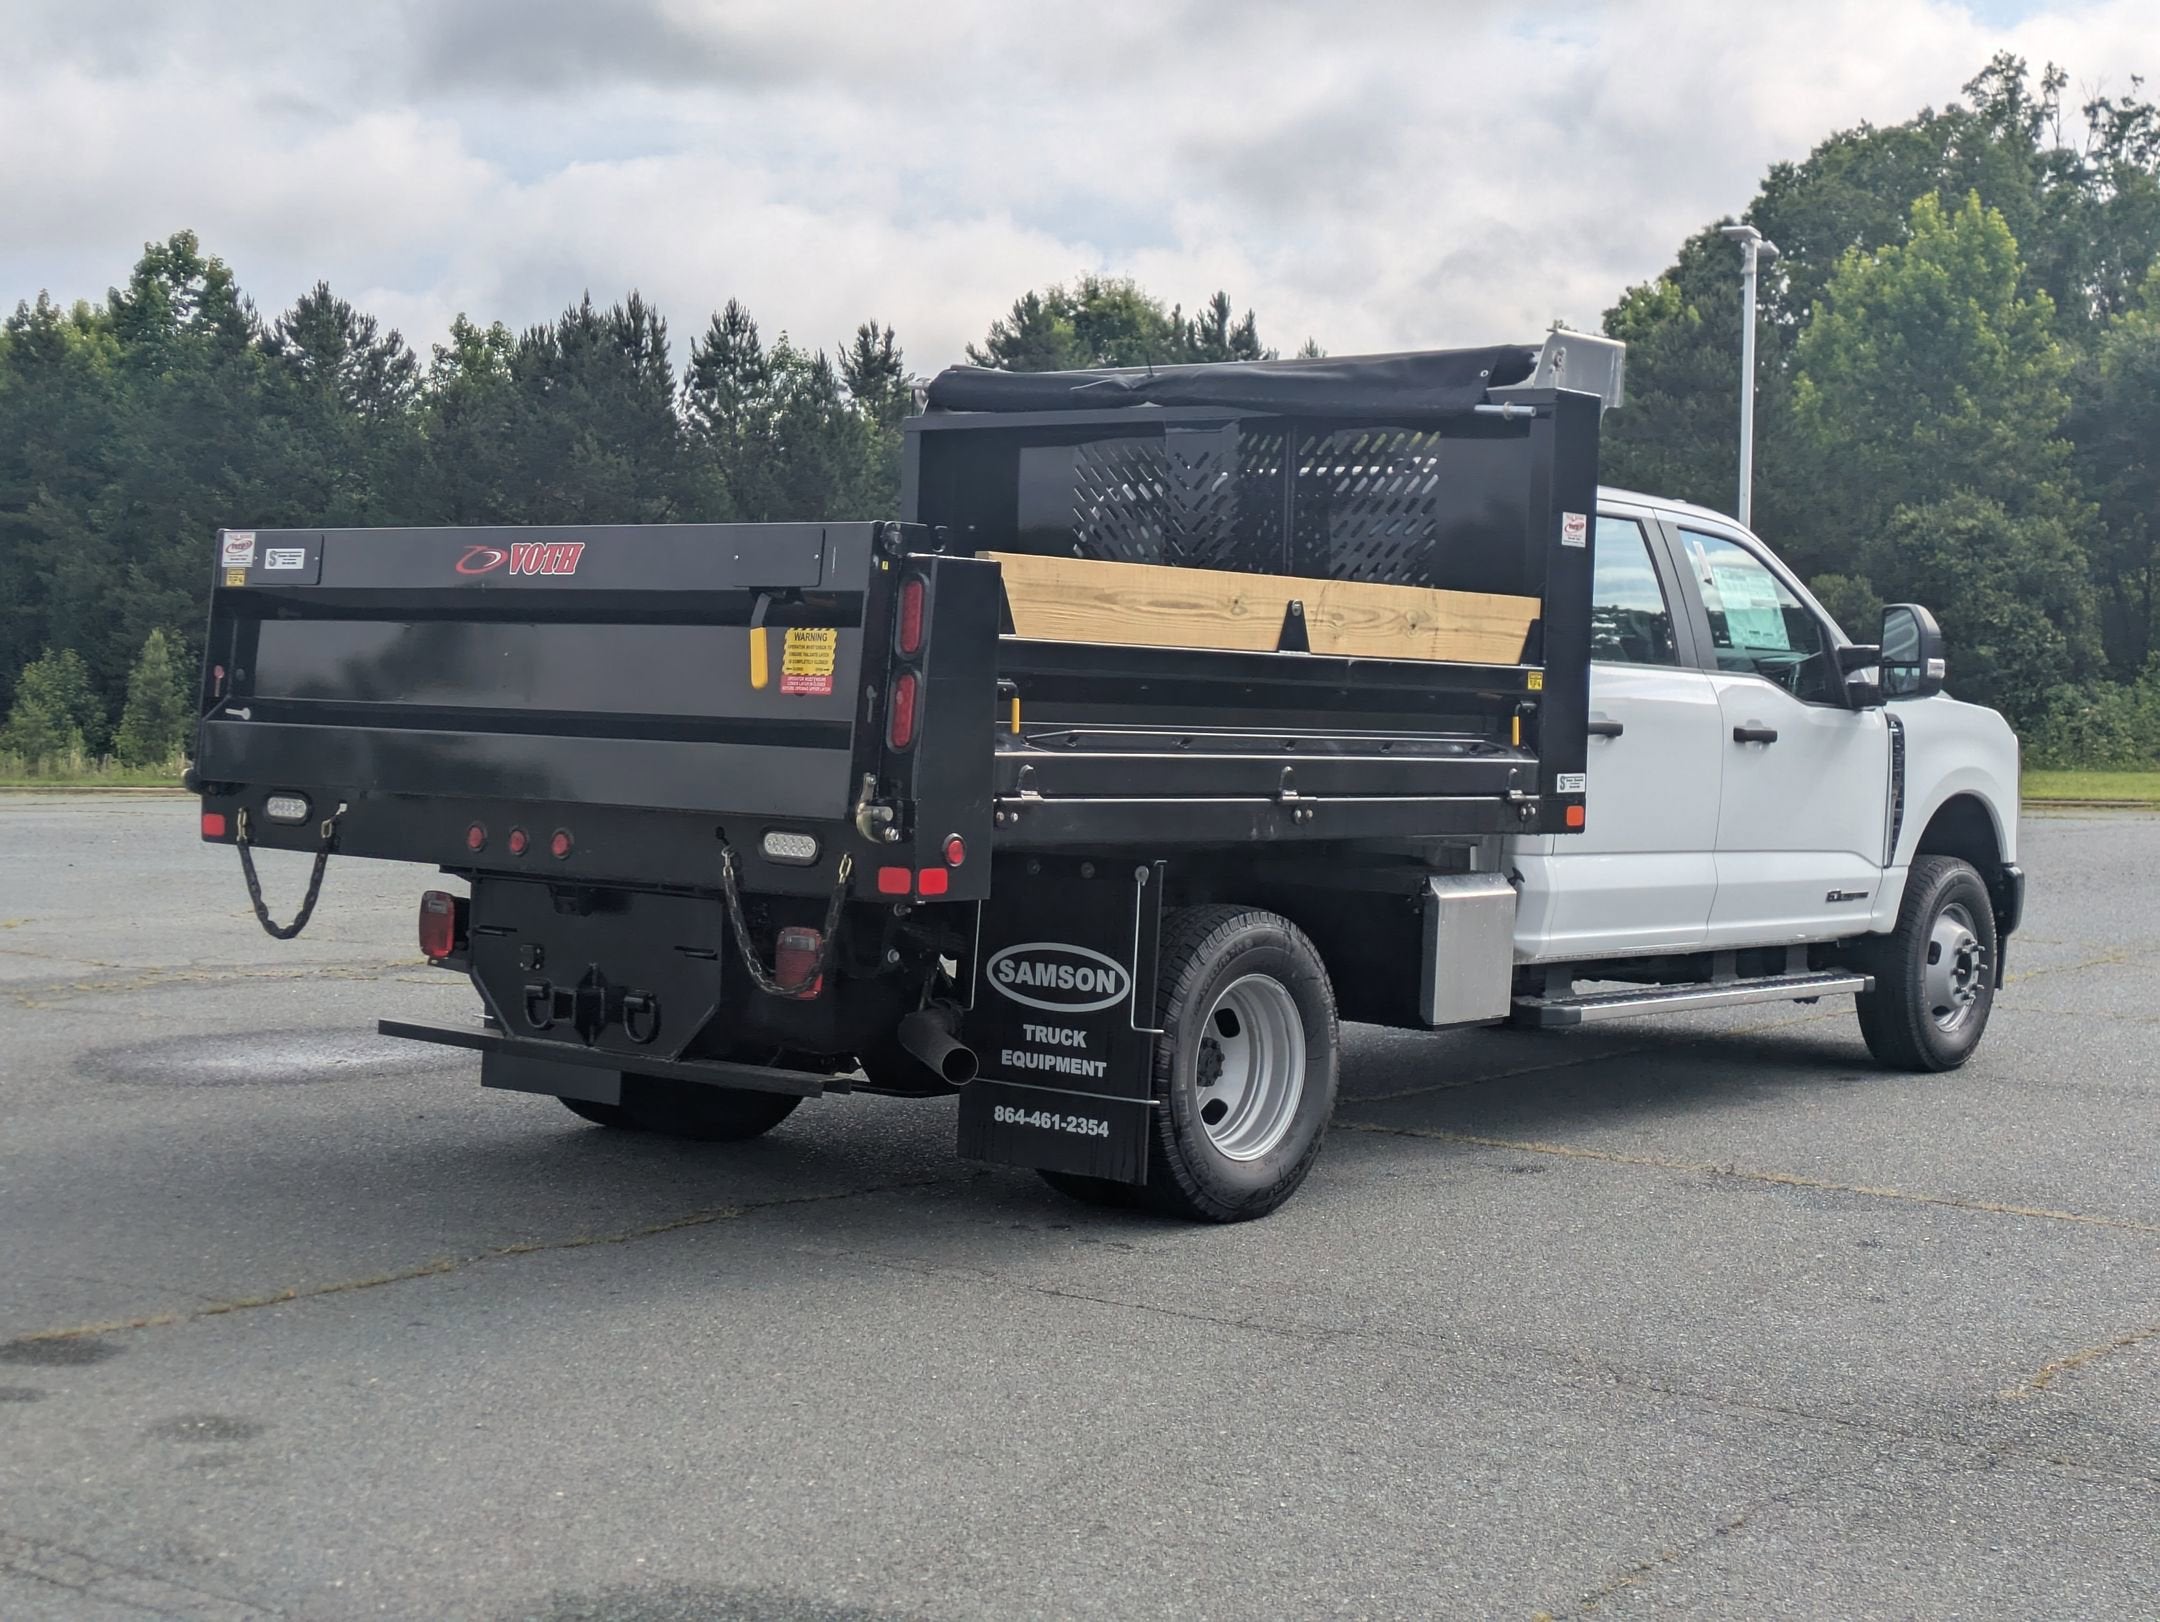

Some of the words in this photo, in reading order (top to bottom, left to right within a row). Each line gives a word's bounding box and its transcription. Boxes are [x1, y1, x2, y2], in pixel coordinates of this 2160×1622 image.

[509, 542, 585, 575] VOTH
[794, 632, 828, 642] WARNING
[998, 959, 1116, 994] SAMSON
[1023, 1024, 1087, 1048] TRUCK
[1001, 1049, 1107, 1078] EQUIPMENT
[994, 1105, 1109, 1137] 864-461-2354
